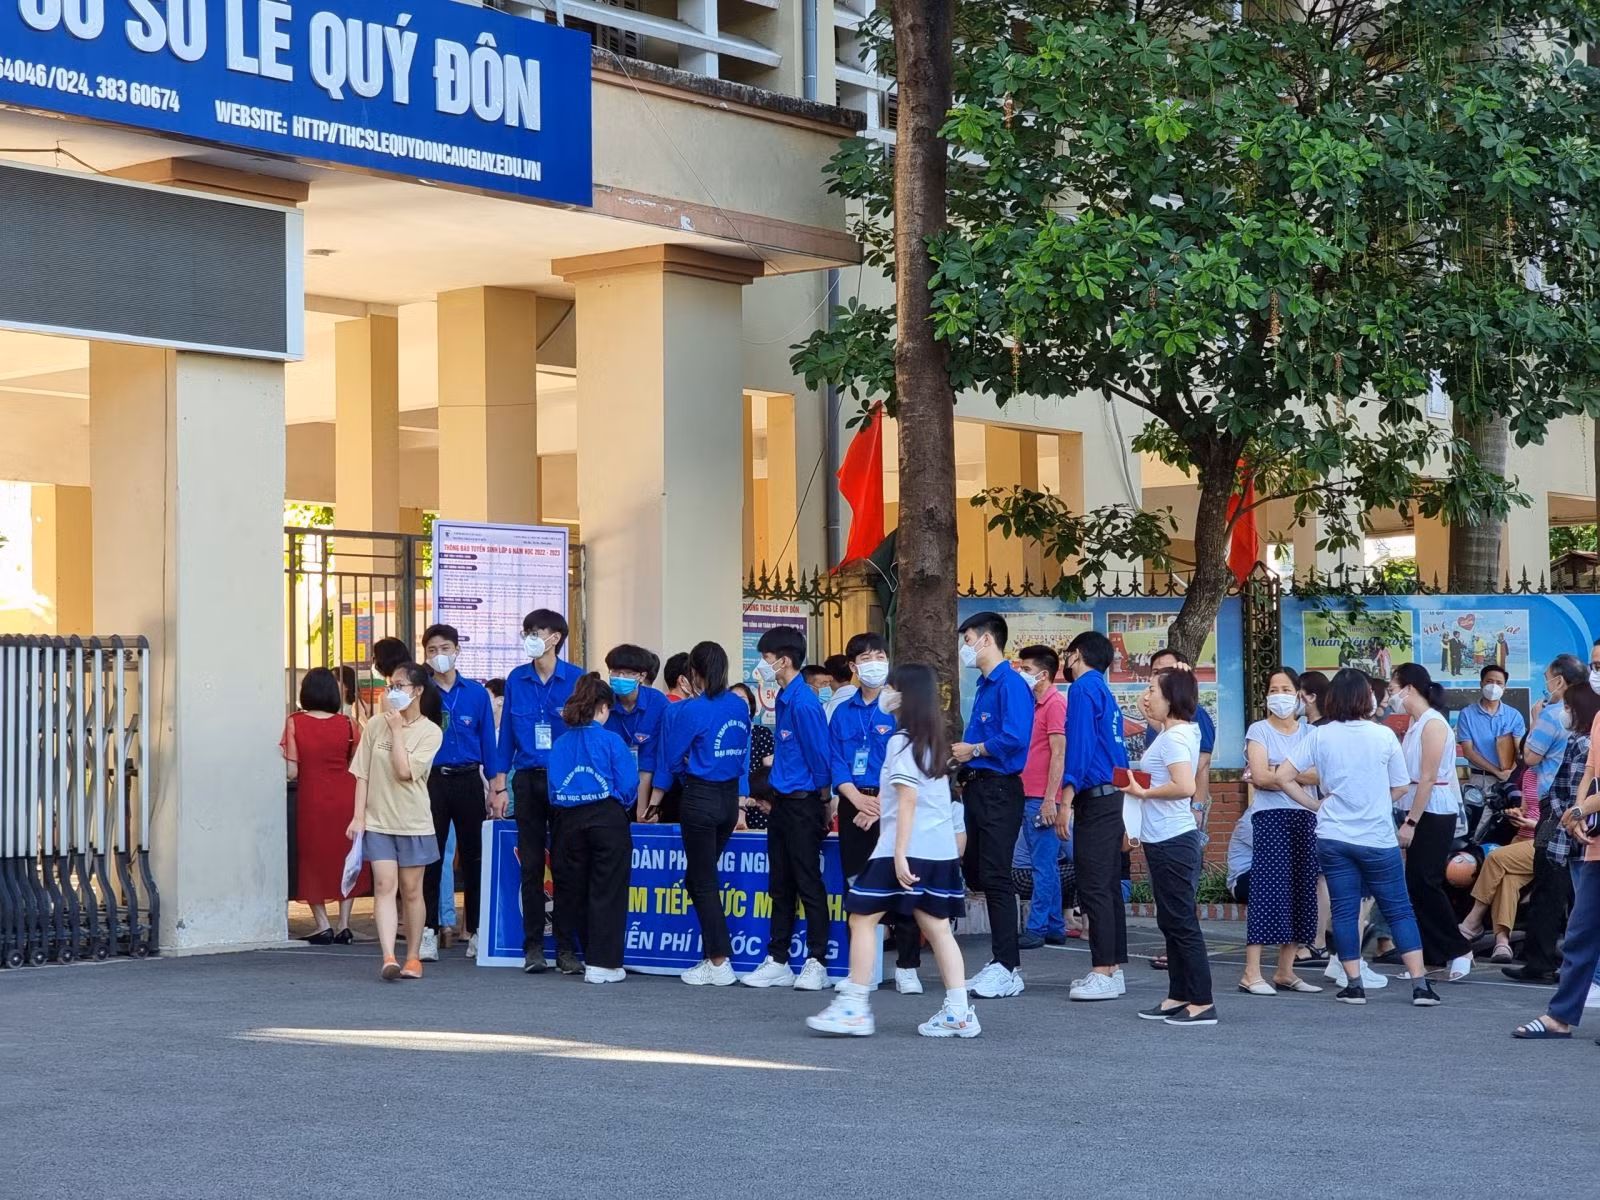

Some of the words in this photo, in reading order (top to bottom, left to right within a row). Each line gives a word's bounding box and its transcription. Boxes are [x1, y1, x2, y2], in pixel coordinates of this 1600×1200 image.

[309, 11, 418, 104] QUÝ
[433, 32, 541, 131] ĐÔN
[96, 76, 127, 103] 383
[130, 83, 180, 112] 60674
[215, 100, 288, 135] WEBSITE:
[631, 845, 664, 870] OÀN
[719, 882, 747, 918] ỨC
[660, 928, 693, 952] PHÍ
